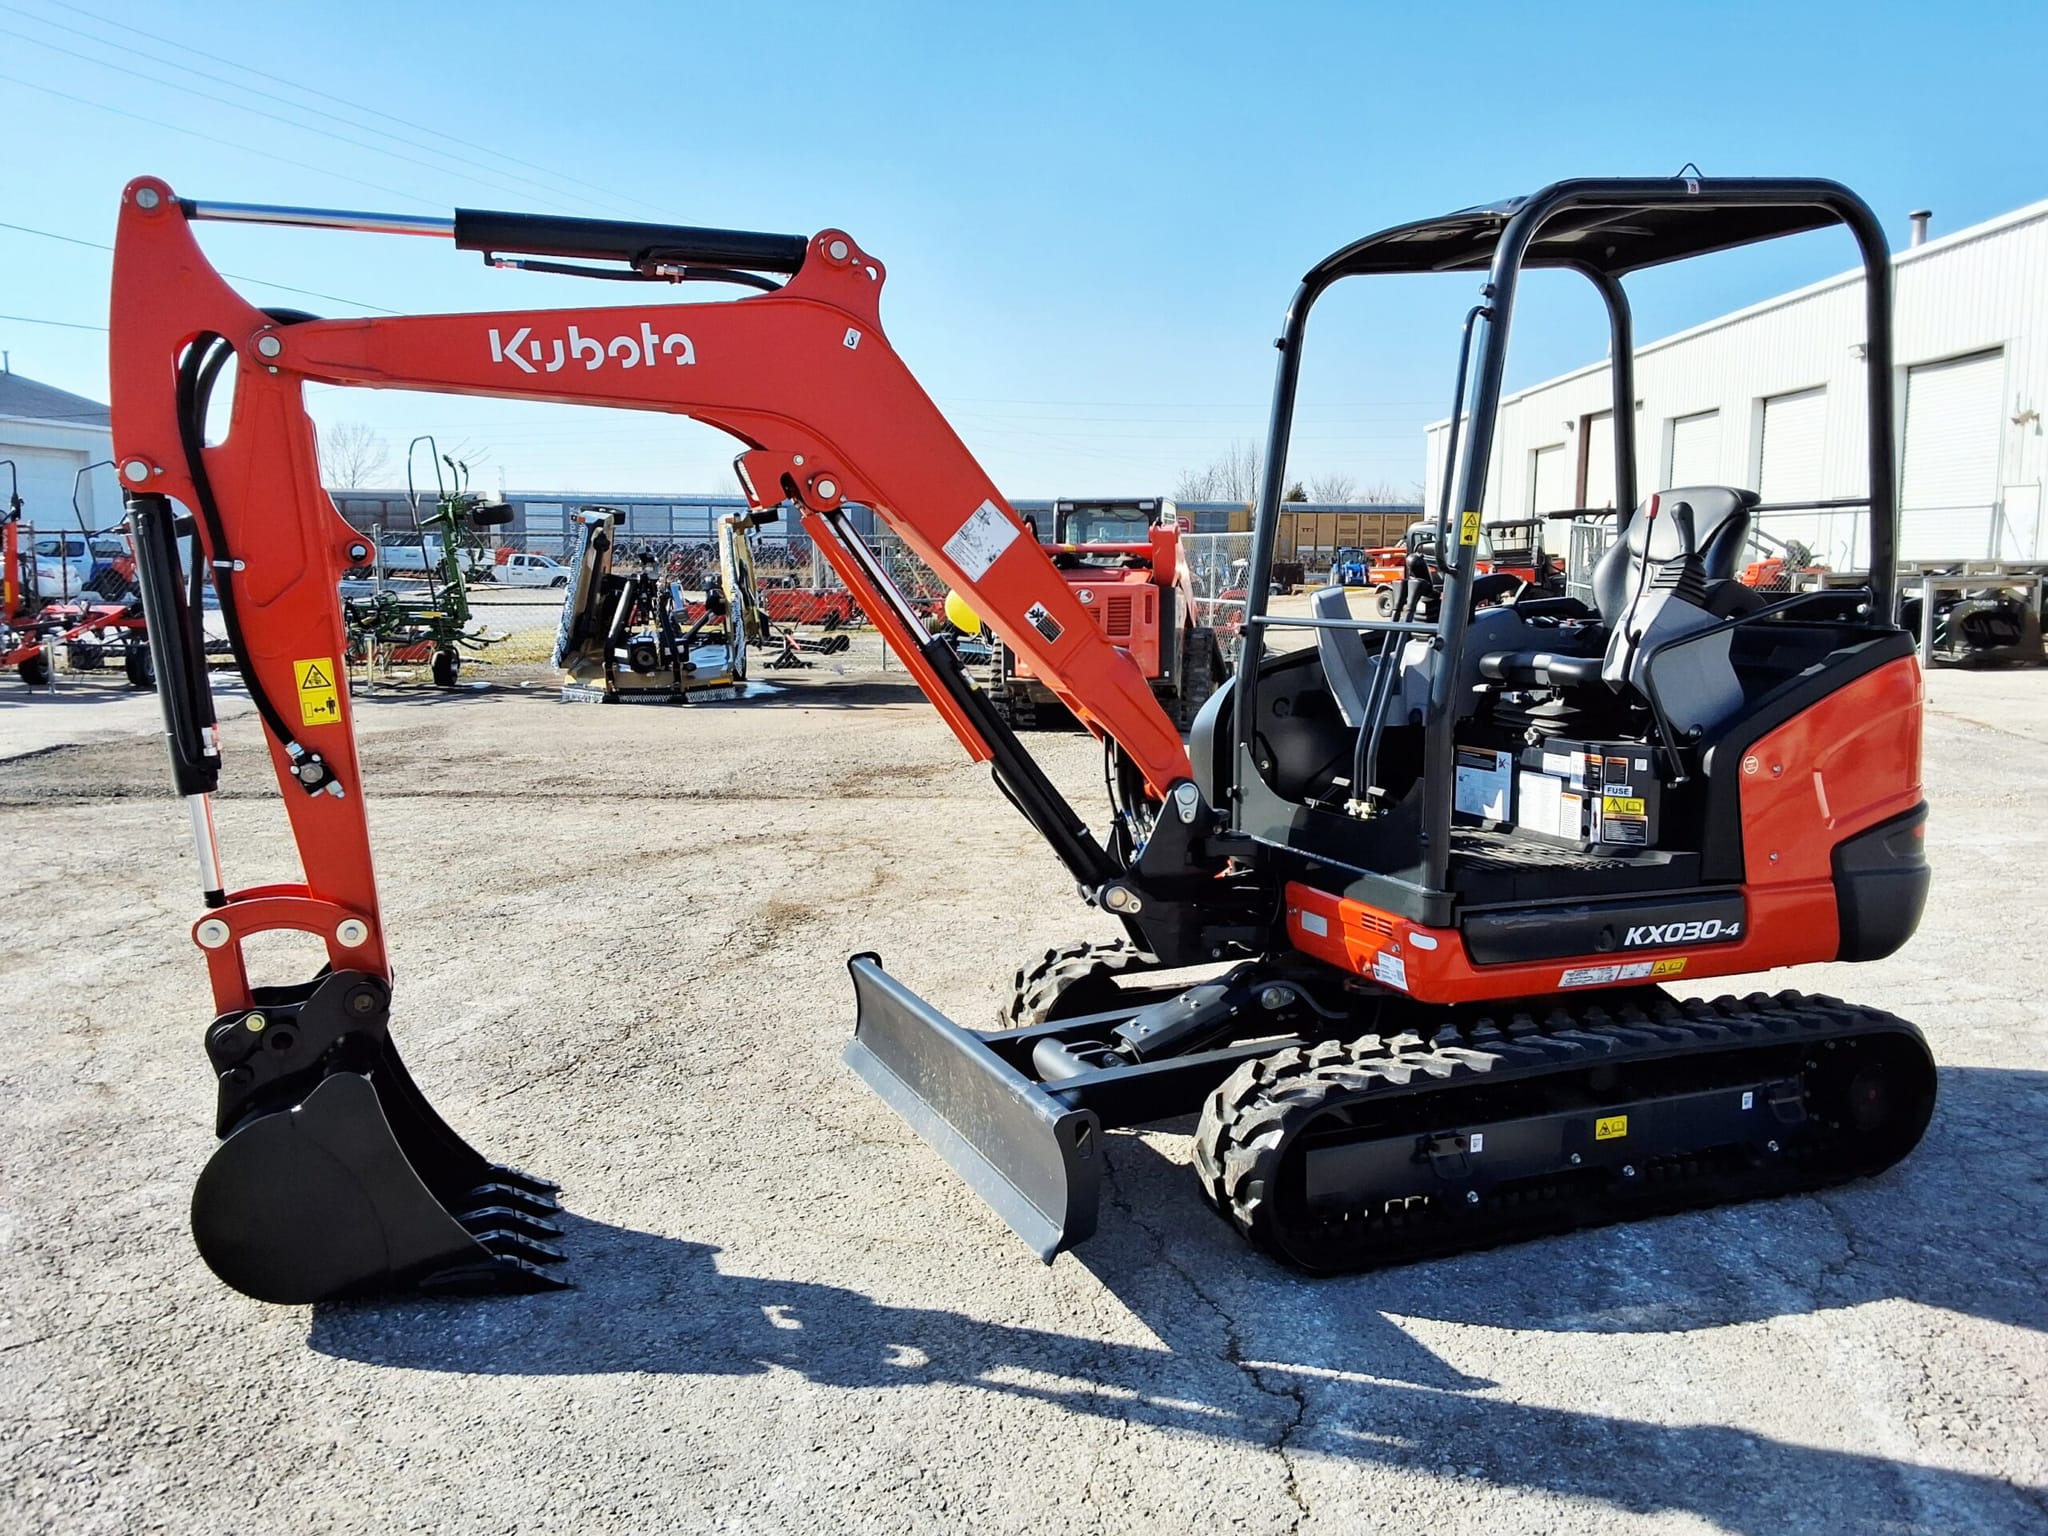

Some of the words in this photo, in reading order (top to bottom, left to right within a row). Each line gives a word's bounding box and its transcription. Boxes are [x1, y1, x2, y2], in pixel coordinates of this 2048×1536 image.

[488, 322, 696, 373] Kubota
[1606, 786, 1630, 796] FUSE
[1624, 919, 1739, 946] KX030-4
